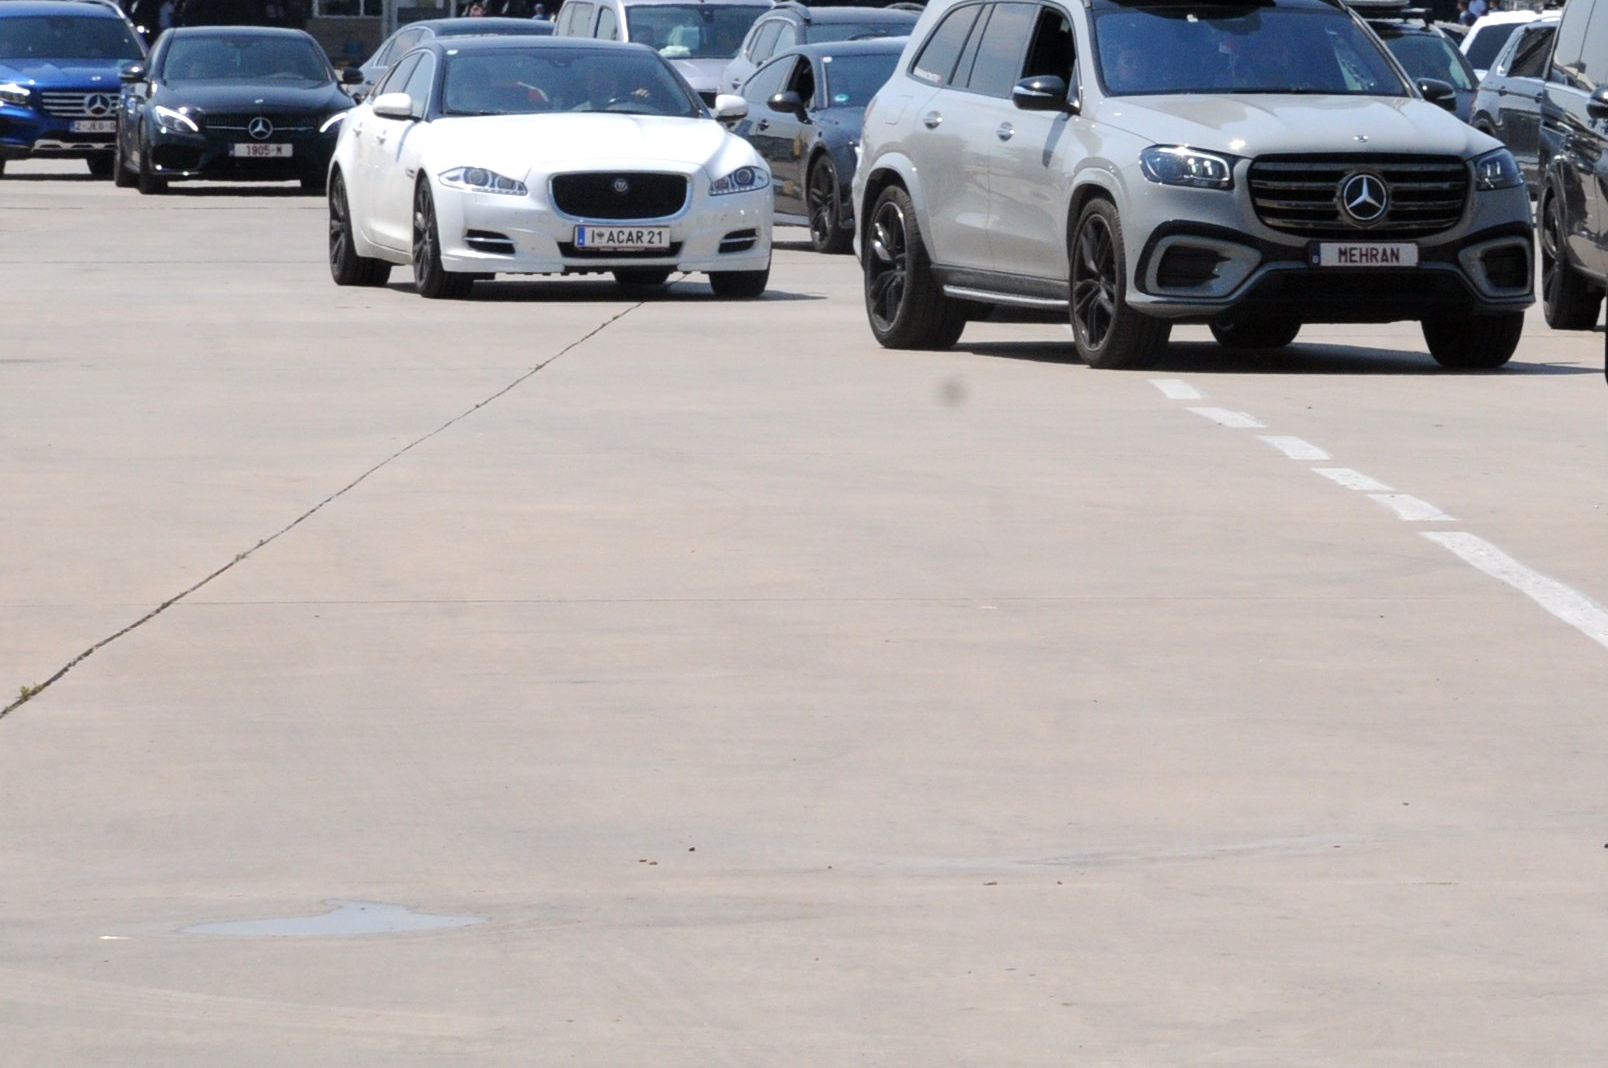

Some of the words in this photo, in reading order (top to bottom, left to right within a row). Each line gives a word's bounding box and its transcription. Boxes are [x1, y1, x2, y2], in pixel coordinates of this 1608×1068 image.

[606, 230, 644, 244] ACAR
[647, 230, 663, 244] 21
[1337, 246, 1400, 264] MEHRAN
